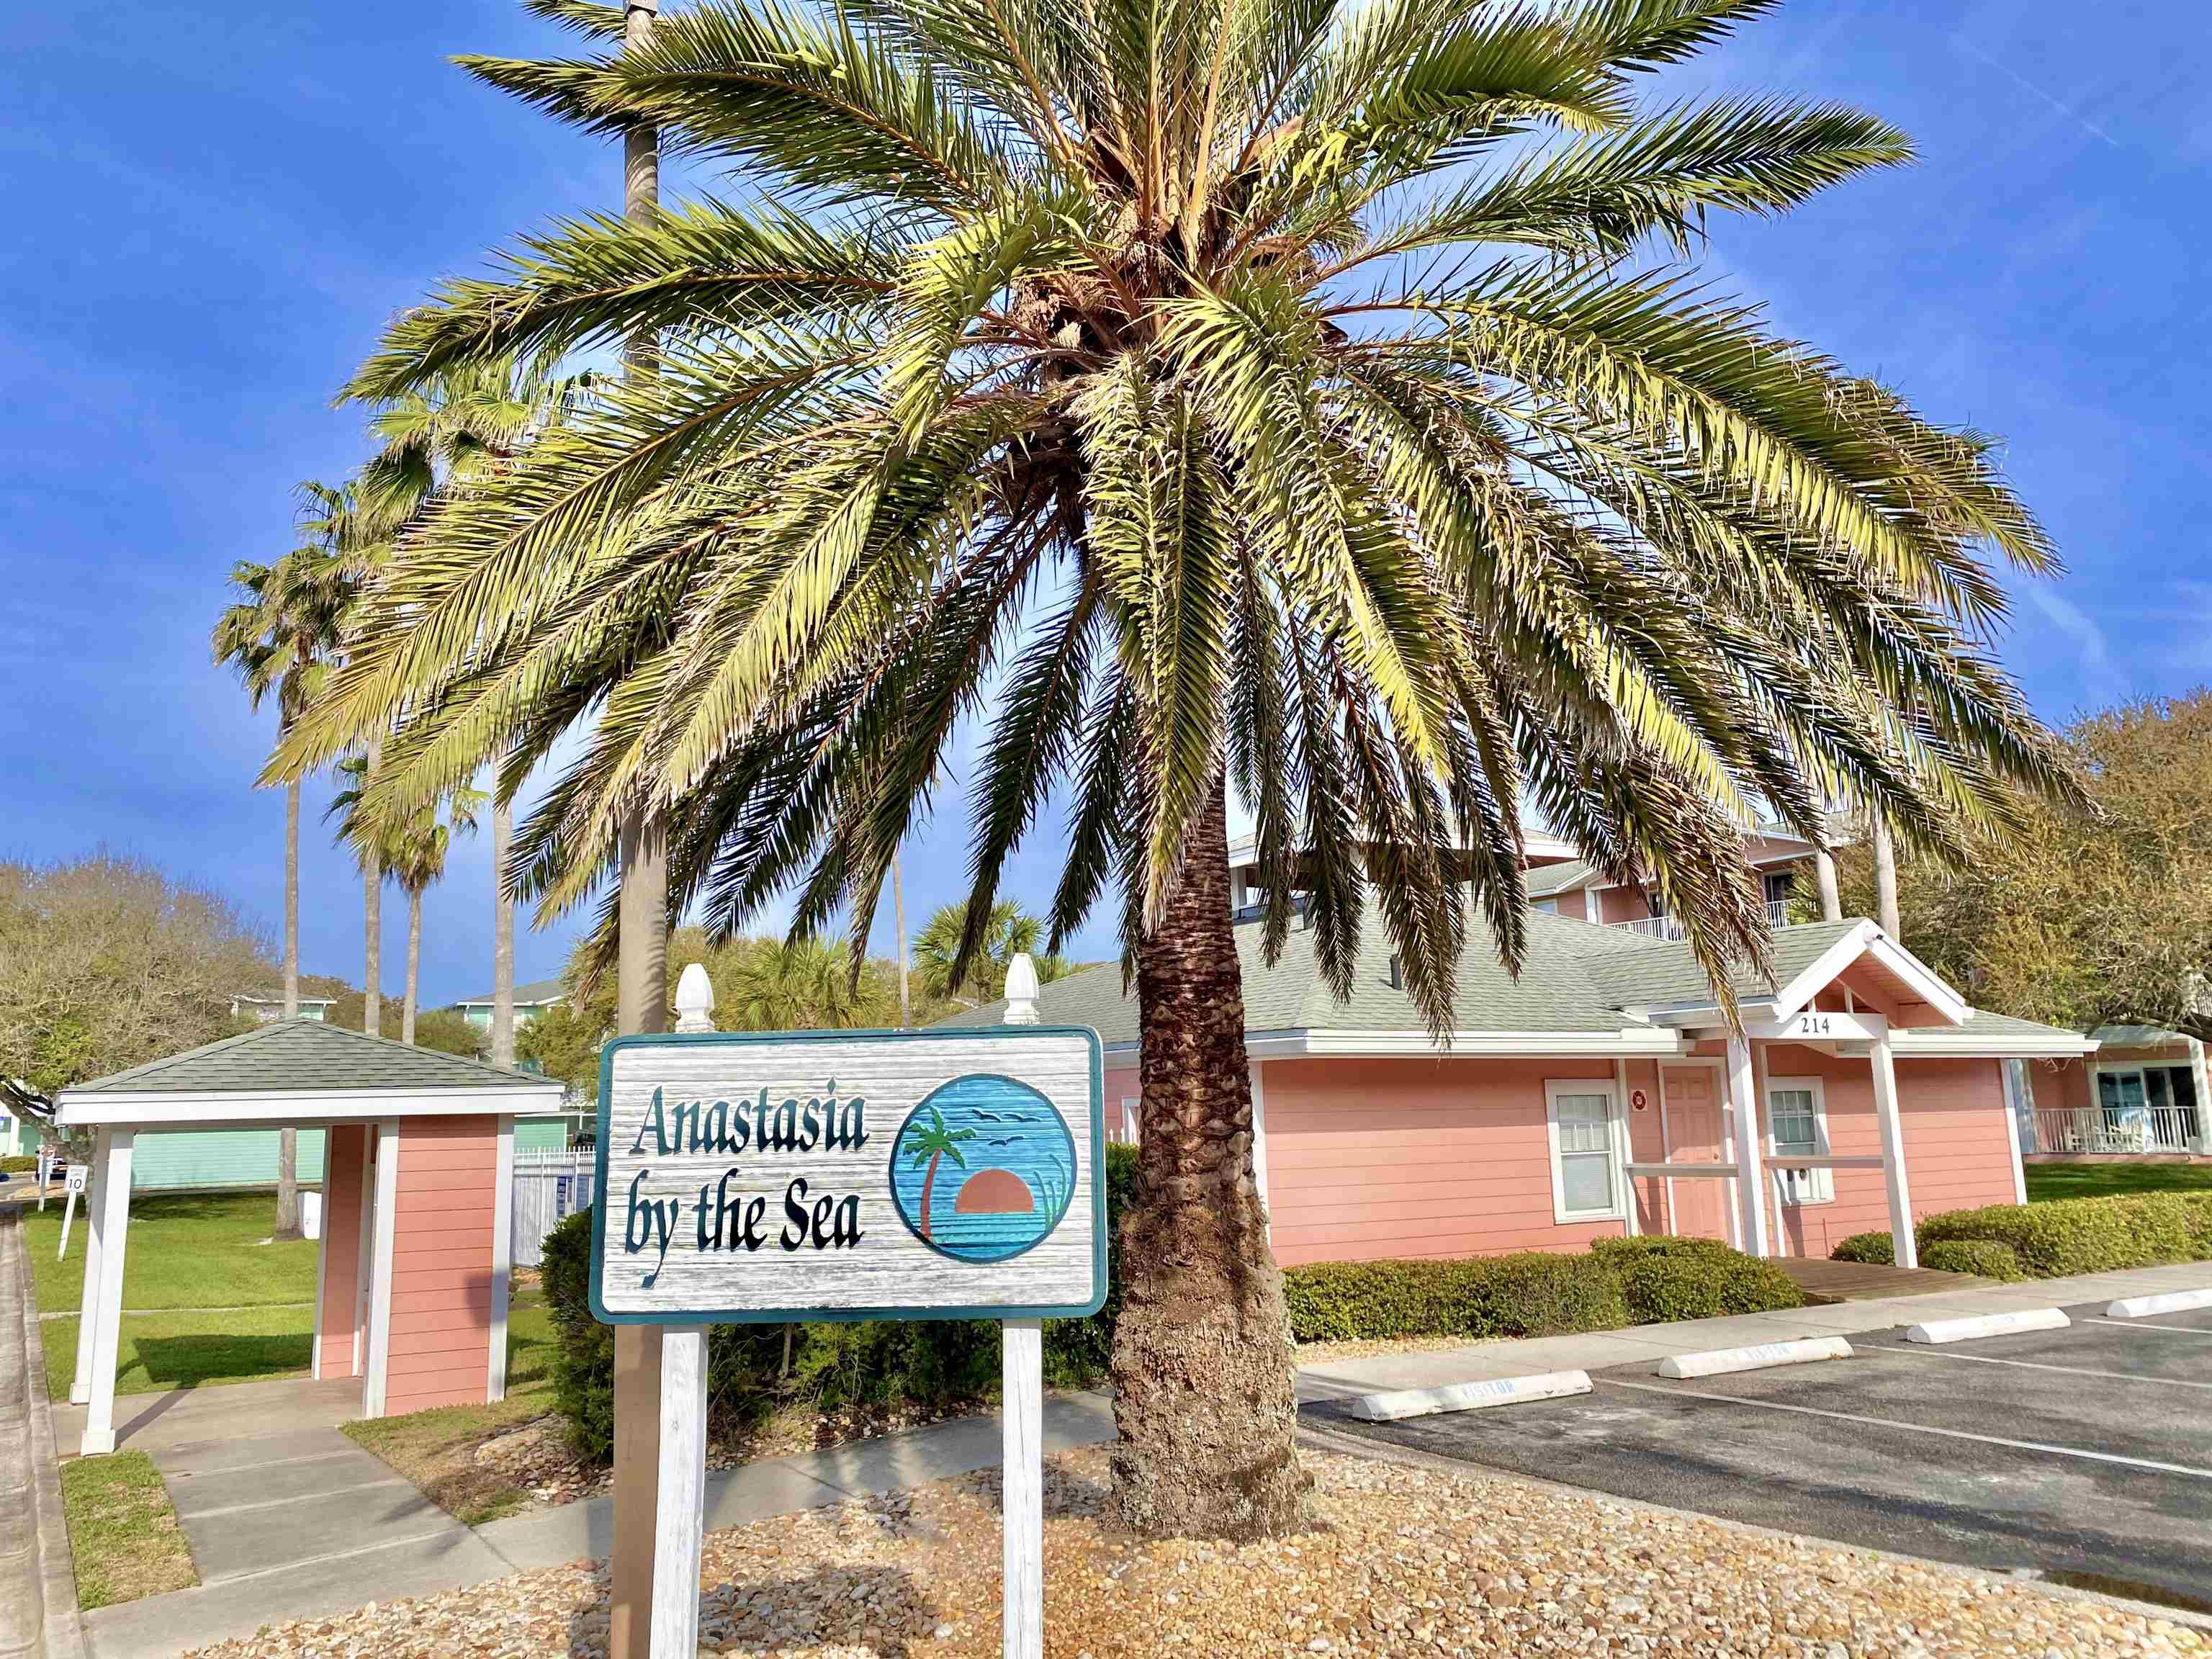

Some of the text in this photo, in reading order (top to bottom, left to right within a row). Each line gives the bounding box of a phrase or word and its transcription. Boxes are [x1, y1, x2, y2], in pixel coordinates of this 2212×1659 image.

[1802, 1017, 1830, 1034] 214
[629, 1077, 870, 1156] Anastasia
[69, 1179, 82, 1189] 10
[625, 1169, 678, 1289] by
[693, 1168, 768, 1252] the
[779, 1177, 864, 1251] Sea
